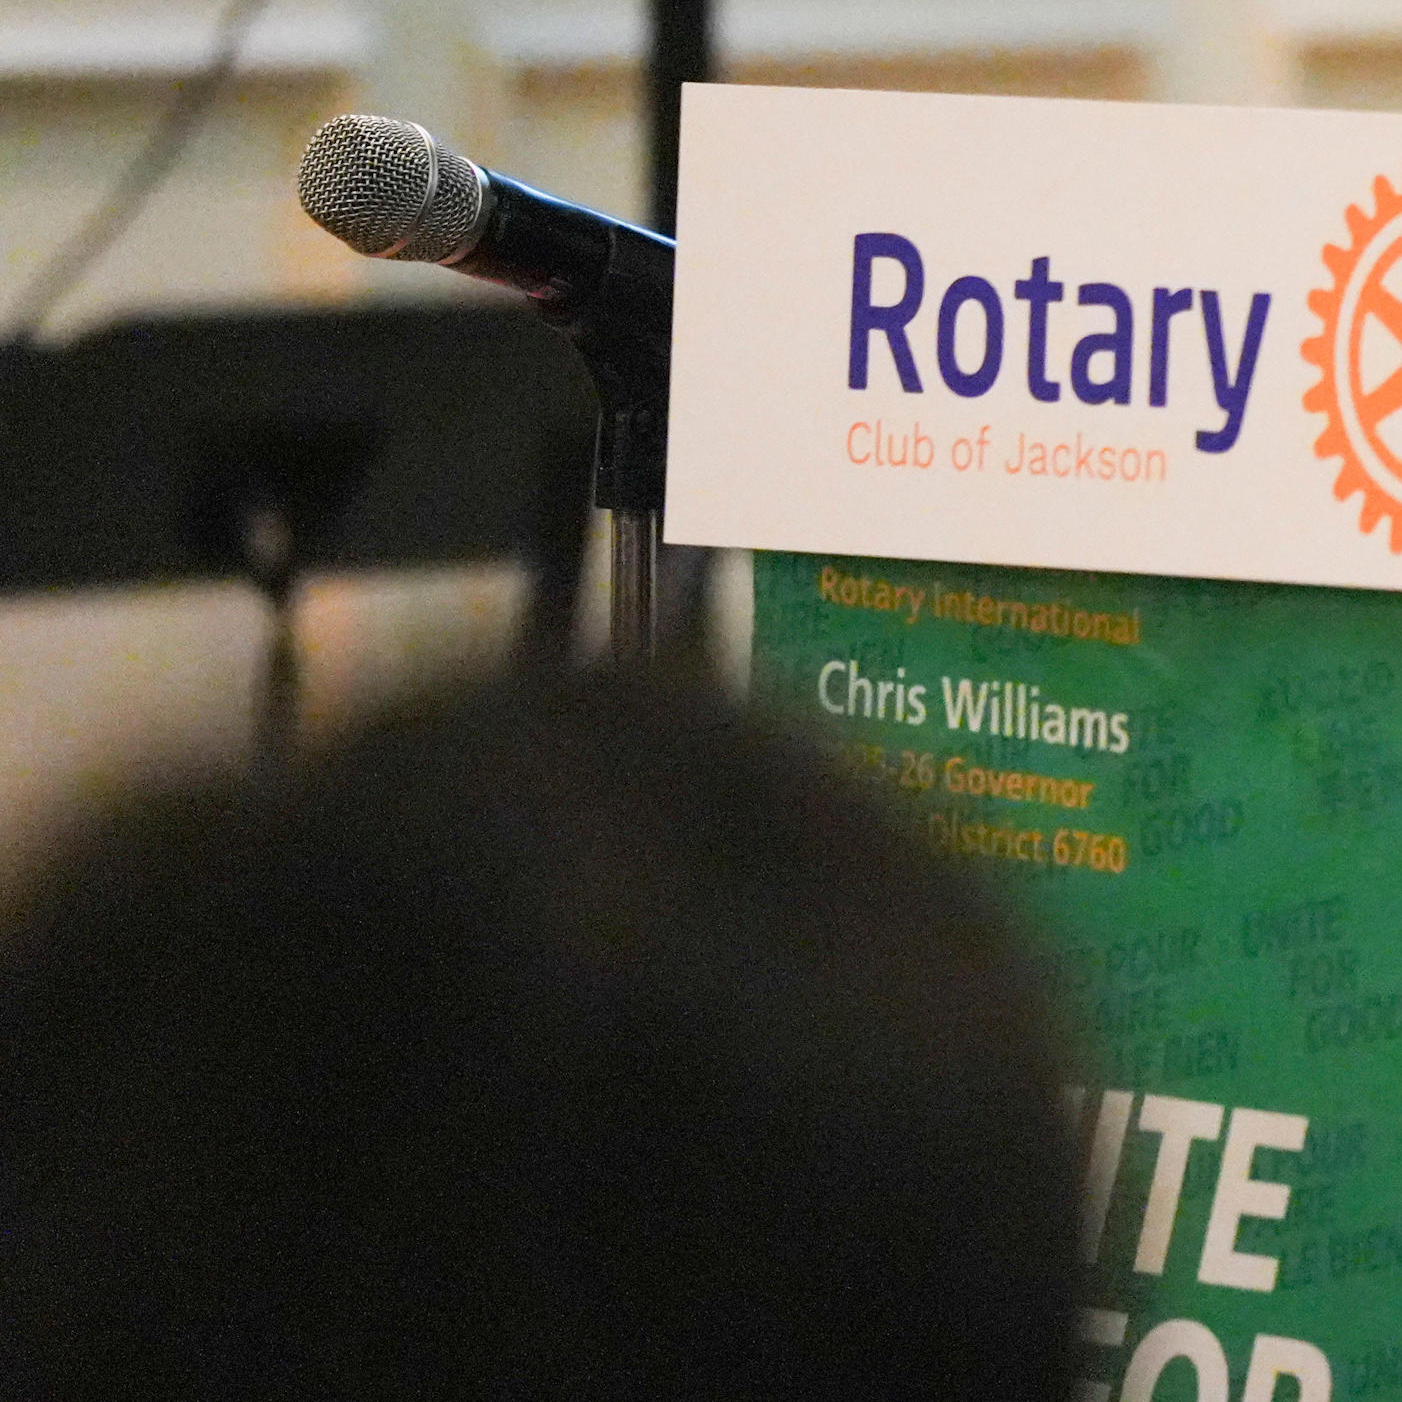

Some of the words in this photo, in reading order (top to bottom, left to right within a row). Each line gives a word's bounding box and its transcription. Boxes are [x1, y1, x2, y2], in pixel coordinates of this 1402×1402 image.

[847, 231, 1270, 455] Rotary
[847, 419, 935, 469] Club
[951, 425, 992, 472] of
[1004, 430, 1167, 482] Jackson
[819, 566, 925, 624] Rotary
[935, 582, 1141, 645] International
[818, 660, 927, 726] Chris
[942, 676, 1131, 753] Williams
[944, 756, 1095, 809] Governor
[1053, 828, 1130, 874] 6760
